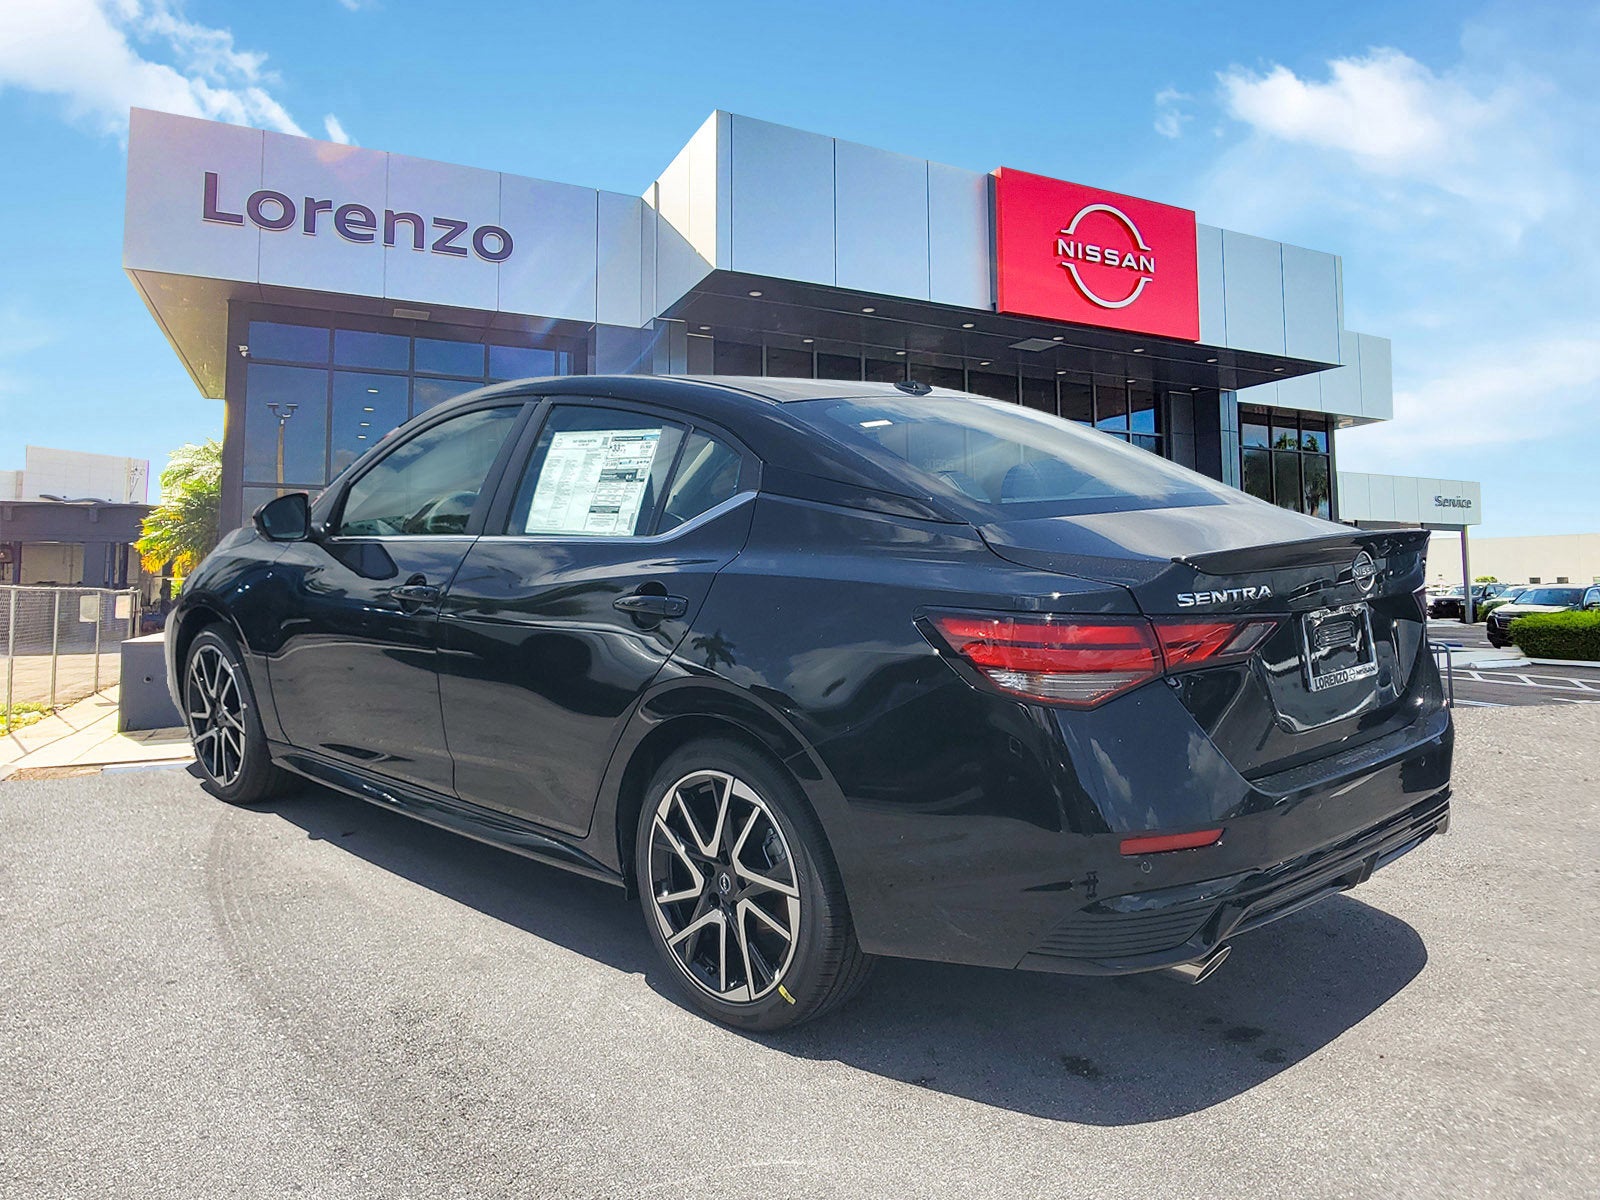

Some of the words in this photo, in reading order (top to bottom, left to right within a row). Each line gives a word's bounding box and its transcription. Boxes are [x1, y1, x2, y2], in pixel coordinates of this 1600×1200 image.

[203, 171, 514, 262] Lorenzo
[1057, 238, 1155, 273] NISSAN
[1434, 495, 1472, 508] Service
[1177, 585, 1273, 607] SENTRA
[1314, 670, 1349, 690] LORENZO
